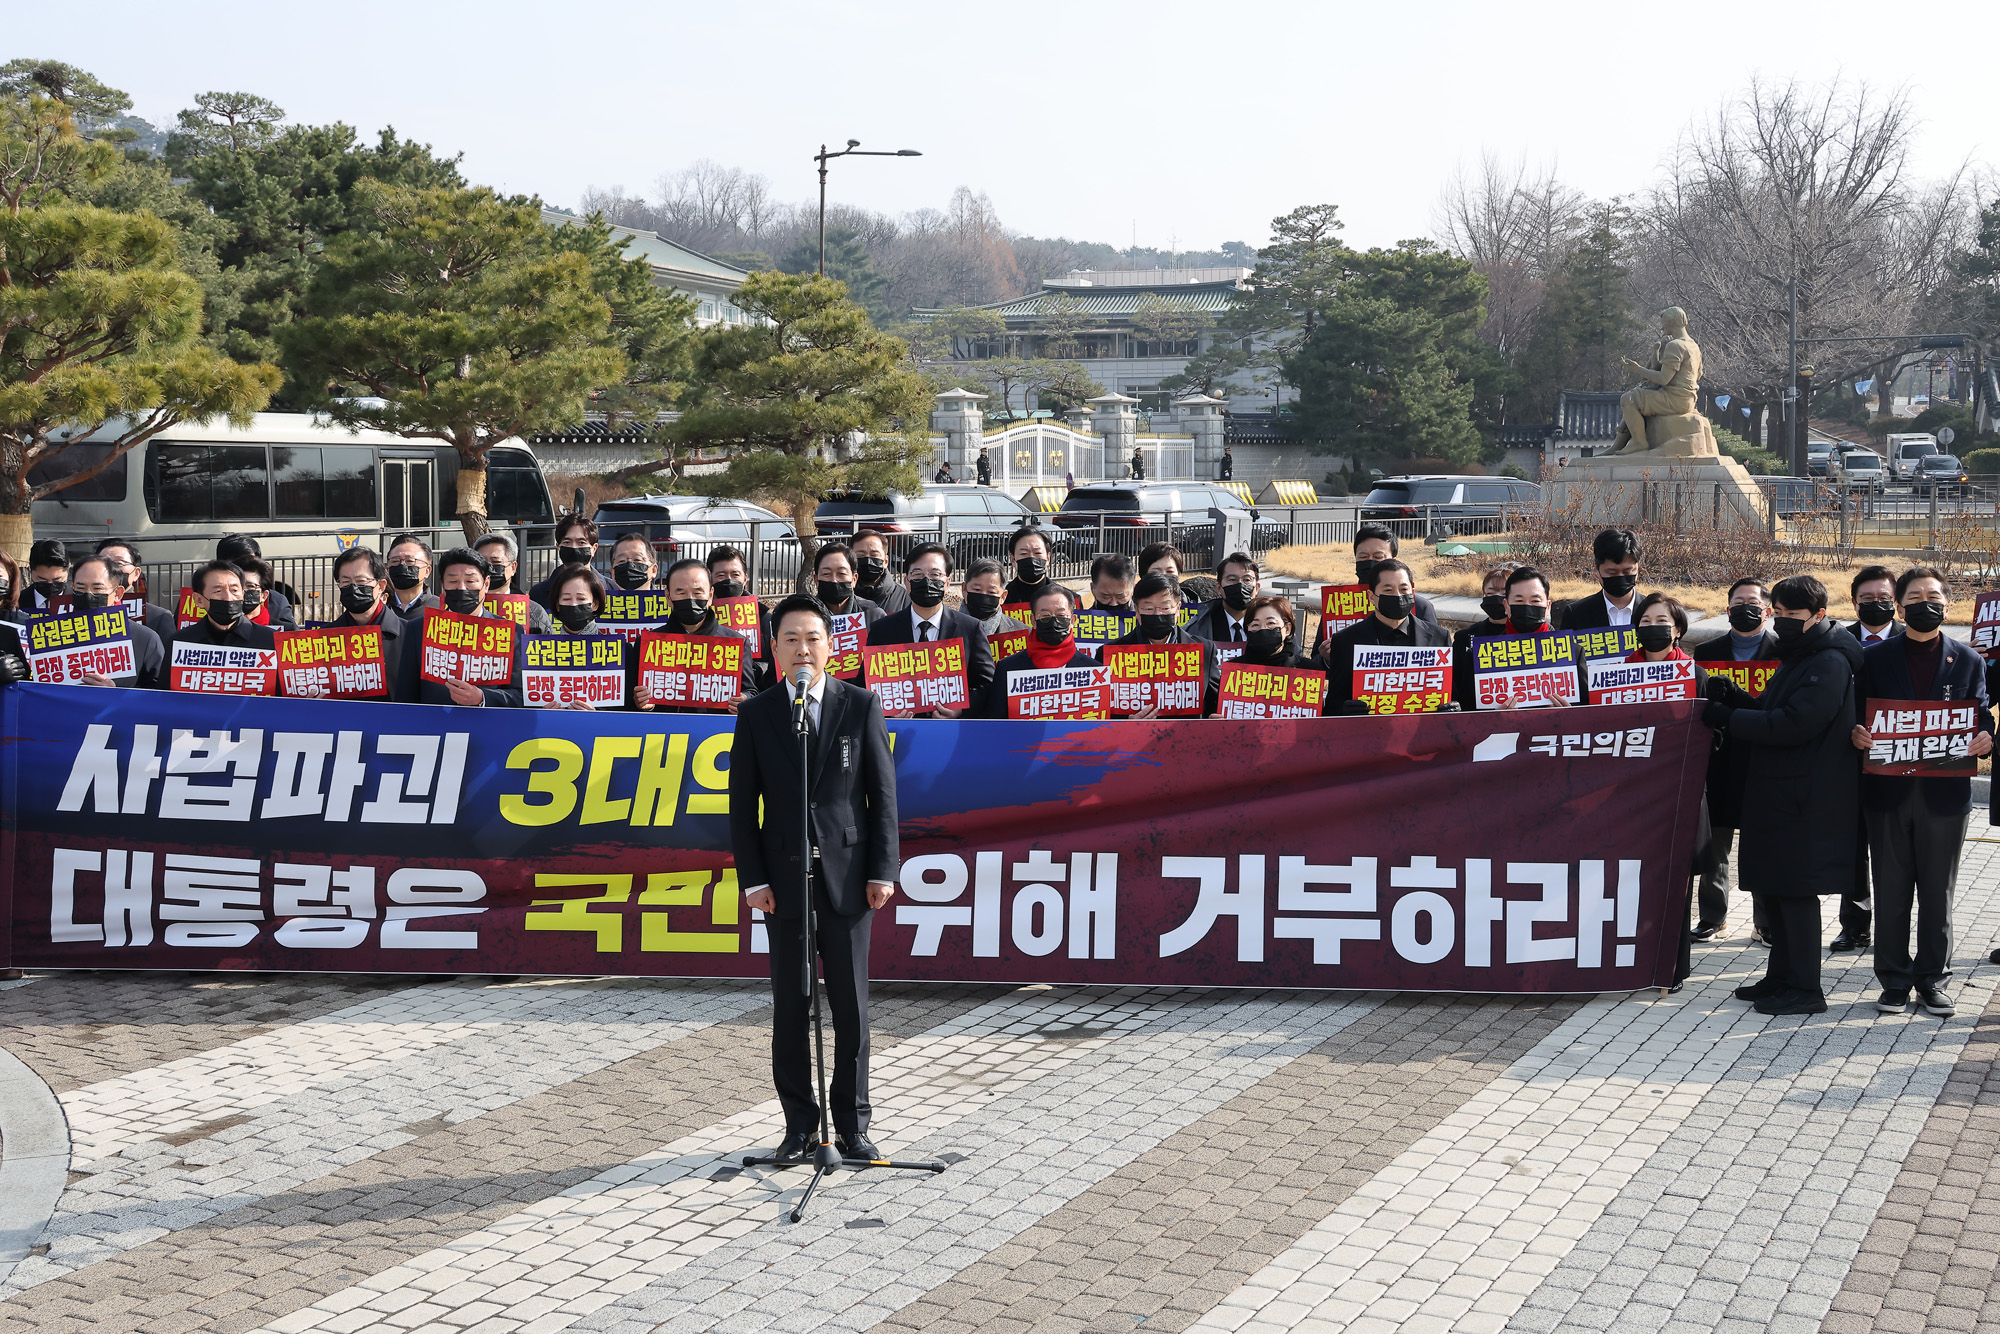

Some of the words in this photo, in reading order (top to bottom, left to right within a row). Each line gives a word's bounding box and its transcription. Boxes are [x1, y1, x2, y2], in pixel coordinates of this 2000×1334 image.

[502, 601, 527, 625] 3법
[600, 595, 639, 619] 분립
[734, 602, 757, 625] 3법
[1326, 590, 1375, 616] 사법파
[1975, 600, 2000, 625] 사
[31, 615, 91, 649] 삼권분립
[93, 610, 127, 638] 파괴
[426, 616, 479, 651] 사법파괴
[482, 626, 511, 653] 3법
[831, 617, 847, 633] 법
[281, 634, 346, 664] 사법파괴
[351, 632, 379, 659] 3법
[525, 639, 587, 667] 삼권분립
[591, 639, 622, 667] 파괴
[644, 639, 708, 669] 사법파괴
[711, 644, 740, 671] 3법
[1477, 638, 1537, 669] 삼권분립
[1540, 635, 1573, 663] 파괴
[1573, 630, 1620, 657] 권분립
[1623, 628, 1643, 651] 파
[35, 656, 64, 683] 당장
[67, 646, 131, 679] 중단하라!
[175, 649, 227, 667] 사법파괴
[229, 651, 257, 667] 악법
[425, 646, 458, 680] 대통령은
[460, 653, 509, 682] 거부하라!
[869, 648, 931, 678] 사법파괴
[934, 644, 962, 672] 3법
[1110, 650, 1169, 678] 사법파괴
[1174, 650, 1200, 677] 3법
[1356, 651, 1409, 668] 사법파괴
[1411, 650, 1435, 667] 악법
[180, 670, 265, 692] 대한민국
[283, 666, 330, 697] 대통령은
[331, 662, 382, 693] 거부하라!
[526, 675, 555, 702] 당장
[559, 675, 621, 702] 중단하라!
[643, 670, 687, 701] 대통령은
[689, 673, 737, 702] 거부하라!
[1010, 673, 1062, 693] 사법파괴
[1064, 670, 1091, 688] 악법
[1224, 669, 1288, 701] 사법파괴
[1291, 676, 1321, 704] 3법
[1363, 670, 1444, 693] 대한민국
[1479, 677, 1508, 704] 당장
[1512, 671, 1575, 702] 중단하라!
[1591, 667, 1645, 688] 사법파괴
[1647, 664, 1674, 681] 악법
[870, 680, 915, 711] 대통령은
[916, 675, 965, 707] 거부하라!
[1019, 689, 1101, 716] 대한민국
[1110, 681, 1152, 710] 대통령은
[1153, 680, 1200, 710] 거부하라!
[1357, 693, 1398, 714] 헌정
[1601, 684, 1686, 704] 대한민국
[1870, 709, 1922, 735] 사법
[1925, 706, 1976, 731] 파괴
[1528, 726, 1656, 758] 국민의힘
[1869, 737, 1920, 765] 독재
[1922, 732, 1973, 761] 완성
[56, 724, 470, 824] 사법파괴
[51, 847, 490, 949] 대통령은
[524, 868, 770, 953] 국민
[895, 850, 1119, 960] 위해
[1158, 853, 1642, 969] 거부하라!
